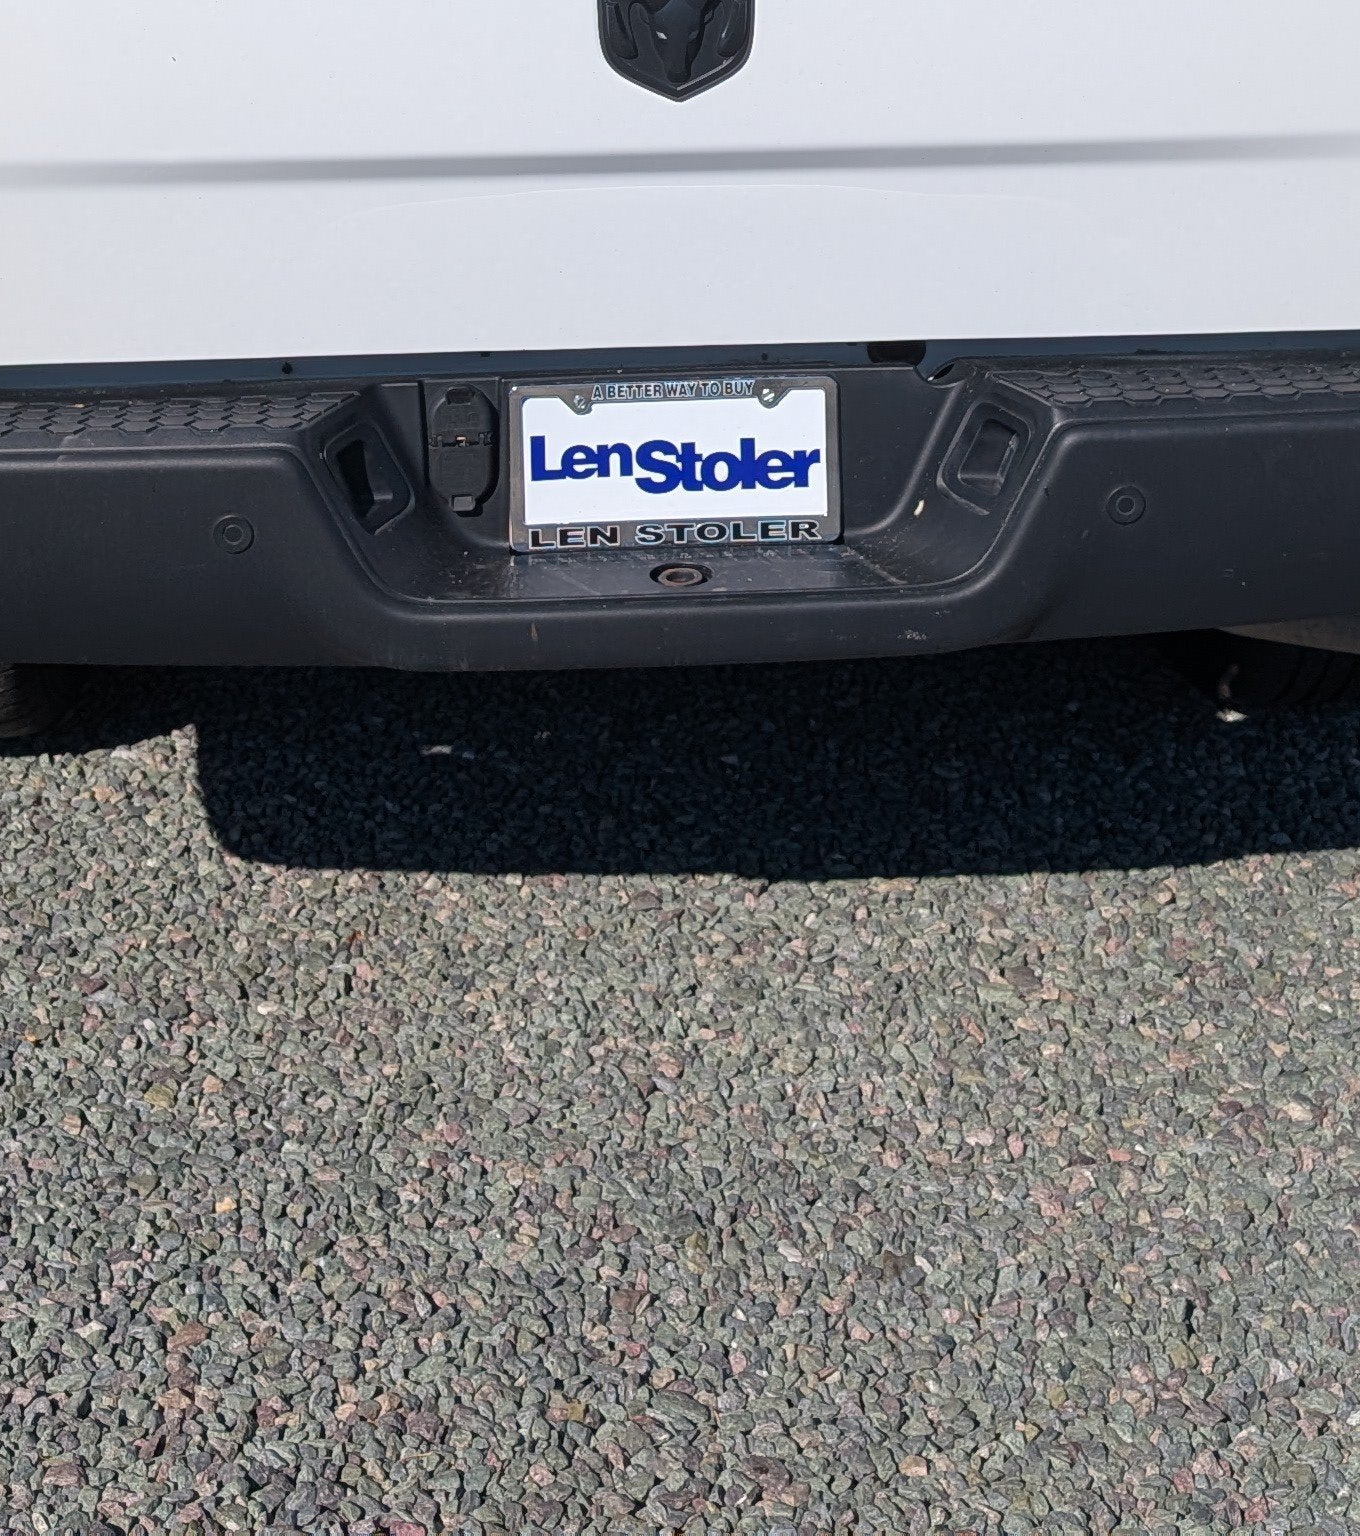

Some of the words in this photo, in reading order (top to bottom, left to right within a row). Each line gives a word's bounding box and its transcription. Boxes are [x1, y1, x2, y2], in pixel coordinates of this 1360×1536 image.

[591, 384, 604, 401] A
[606, 381, 663, 399] BETTER
[664, 380, 698, 397] WAY
[700, 380, 721, 397] TO
[723, 379, 755, 396] BUY
[528, 525, 621, 550] LEN
[634, 519, 822, 545] STOLER
